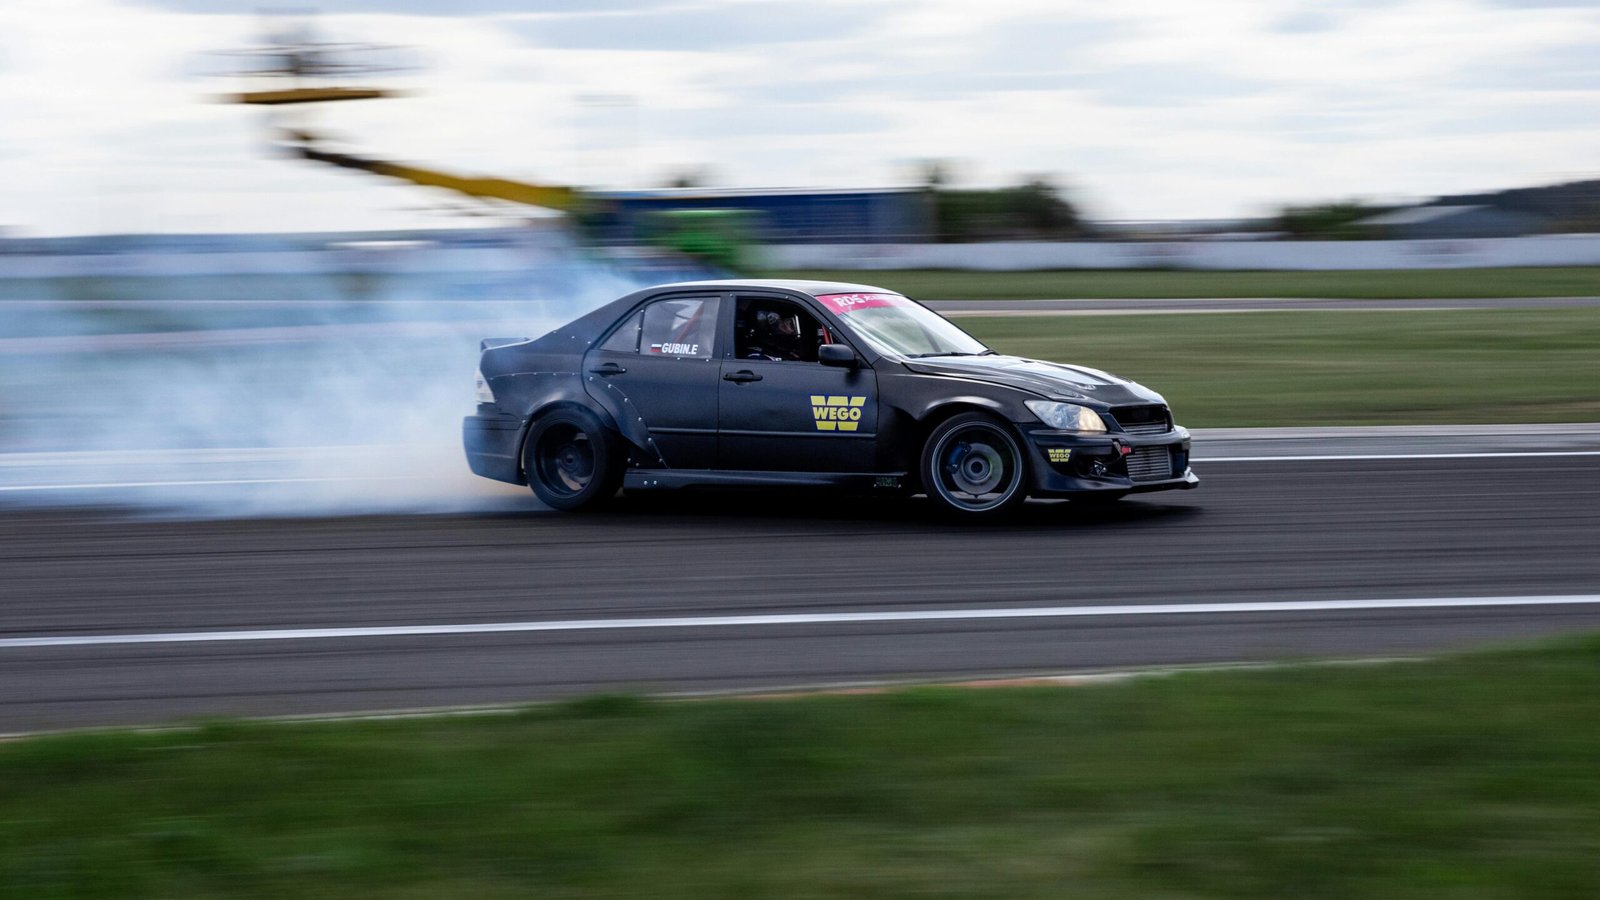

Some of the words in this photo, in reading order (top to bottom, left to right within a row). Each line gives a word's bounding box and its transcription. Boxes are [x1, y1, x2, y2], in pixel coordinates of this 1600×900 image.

[833, 294, 865, 307] RDS
[662, 343, 699, 355] GUBIN.E
[812, 407, 861, 420] WEGO
